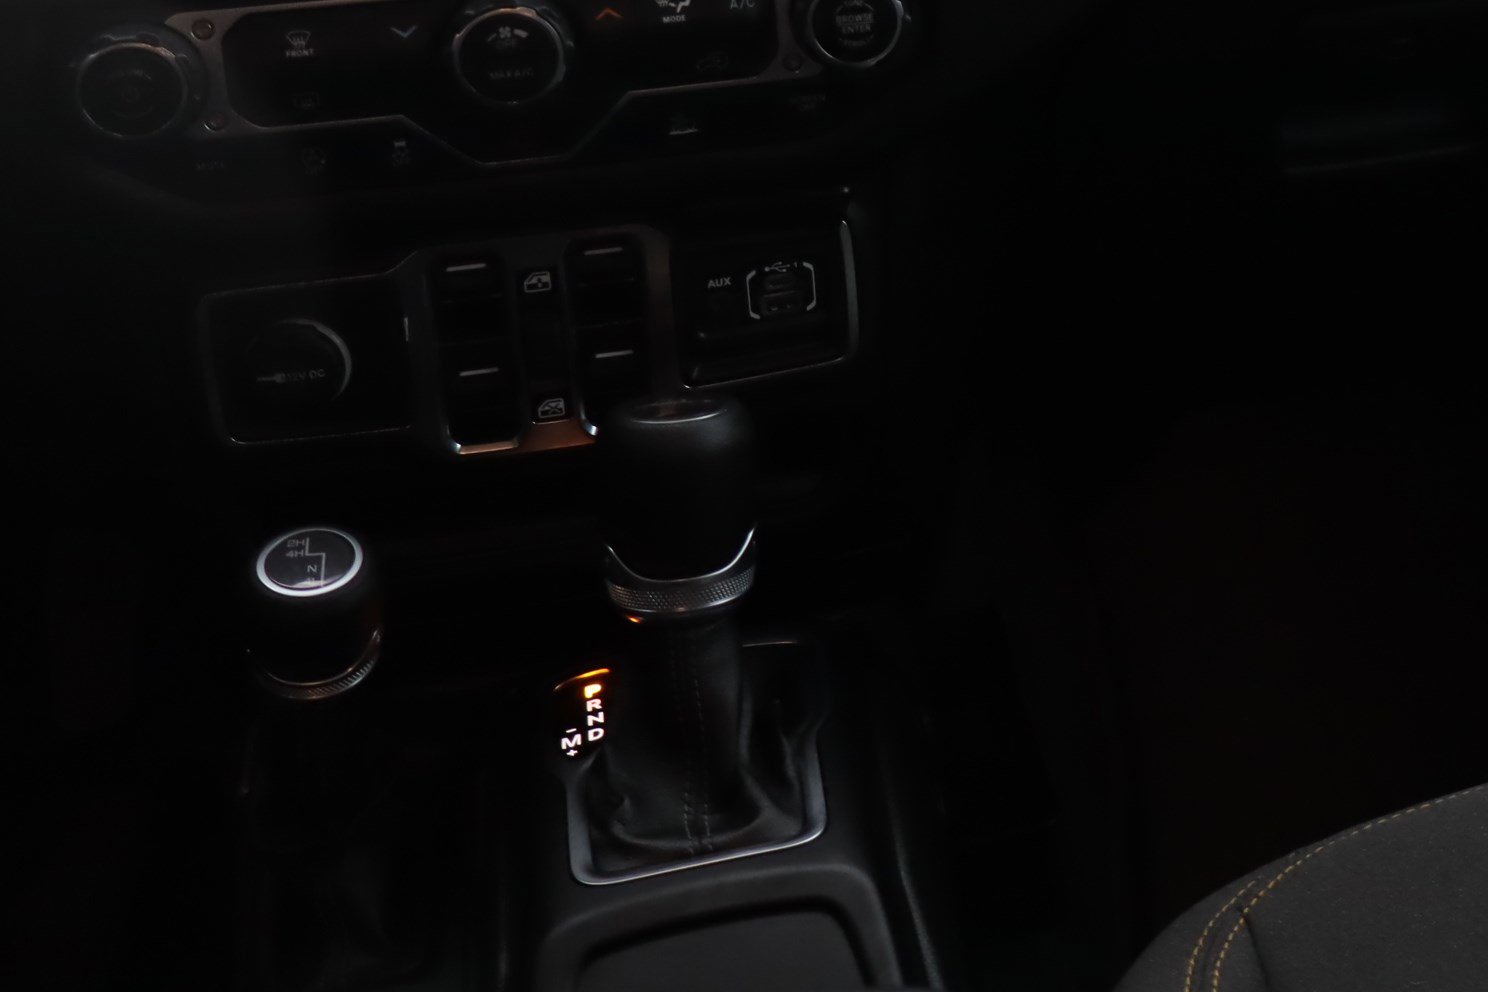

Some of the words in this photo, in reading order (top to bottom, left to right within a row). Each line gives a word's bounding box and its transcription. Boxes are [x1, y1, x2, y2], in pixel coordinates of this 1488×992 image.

[662, 14, 687, 24] MODE
[707, 276, 732, 289] AUX
[306, 564, 318, 573] N
